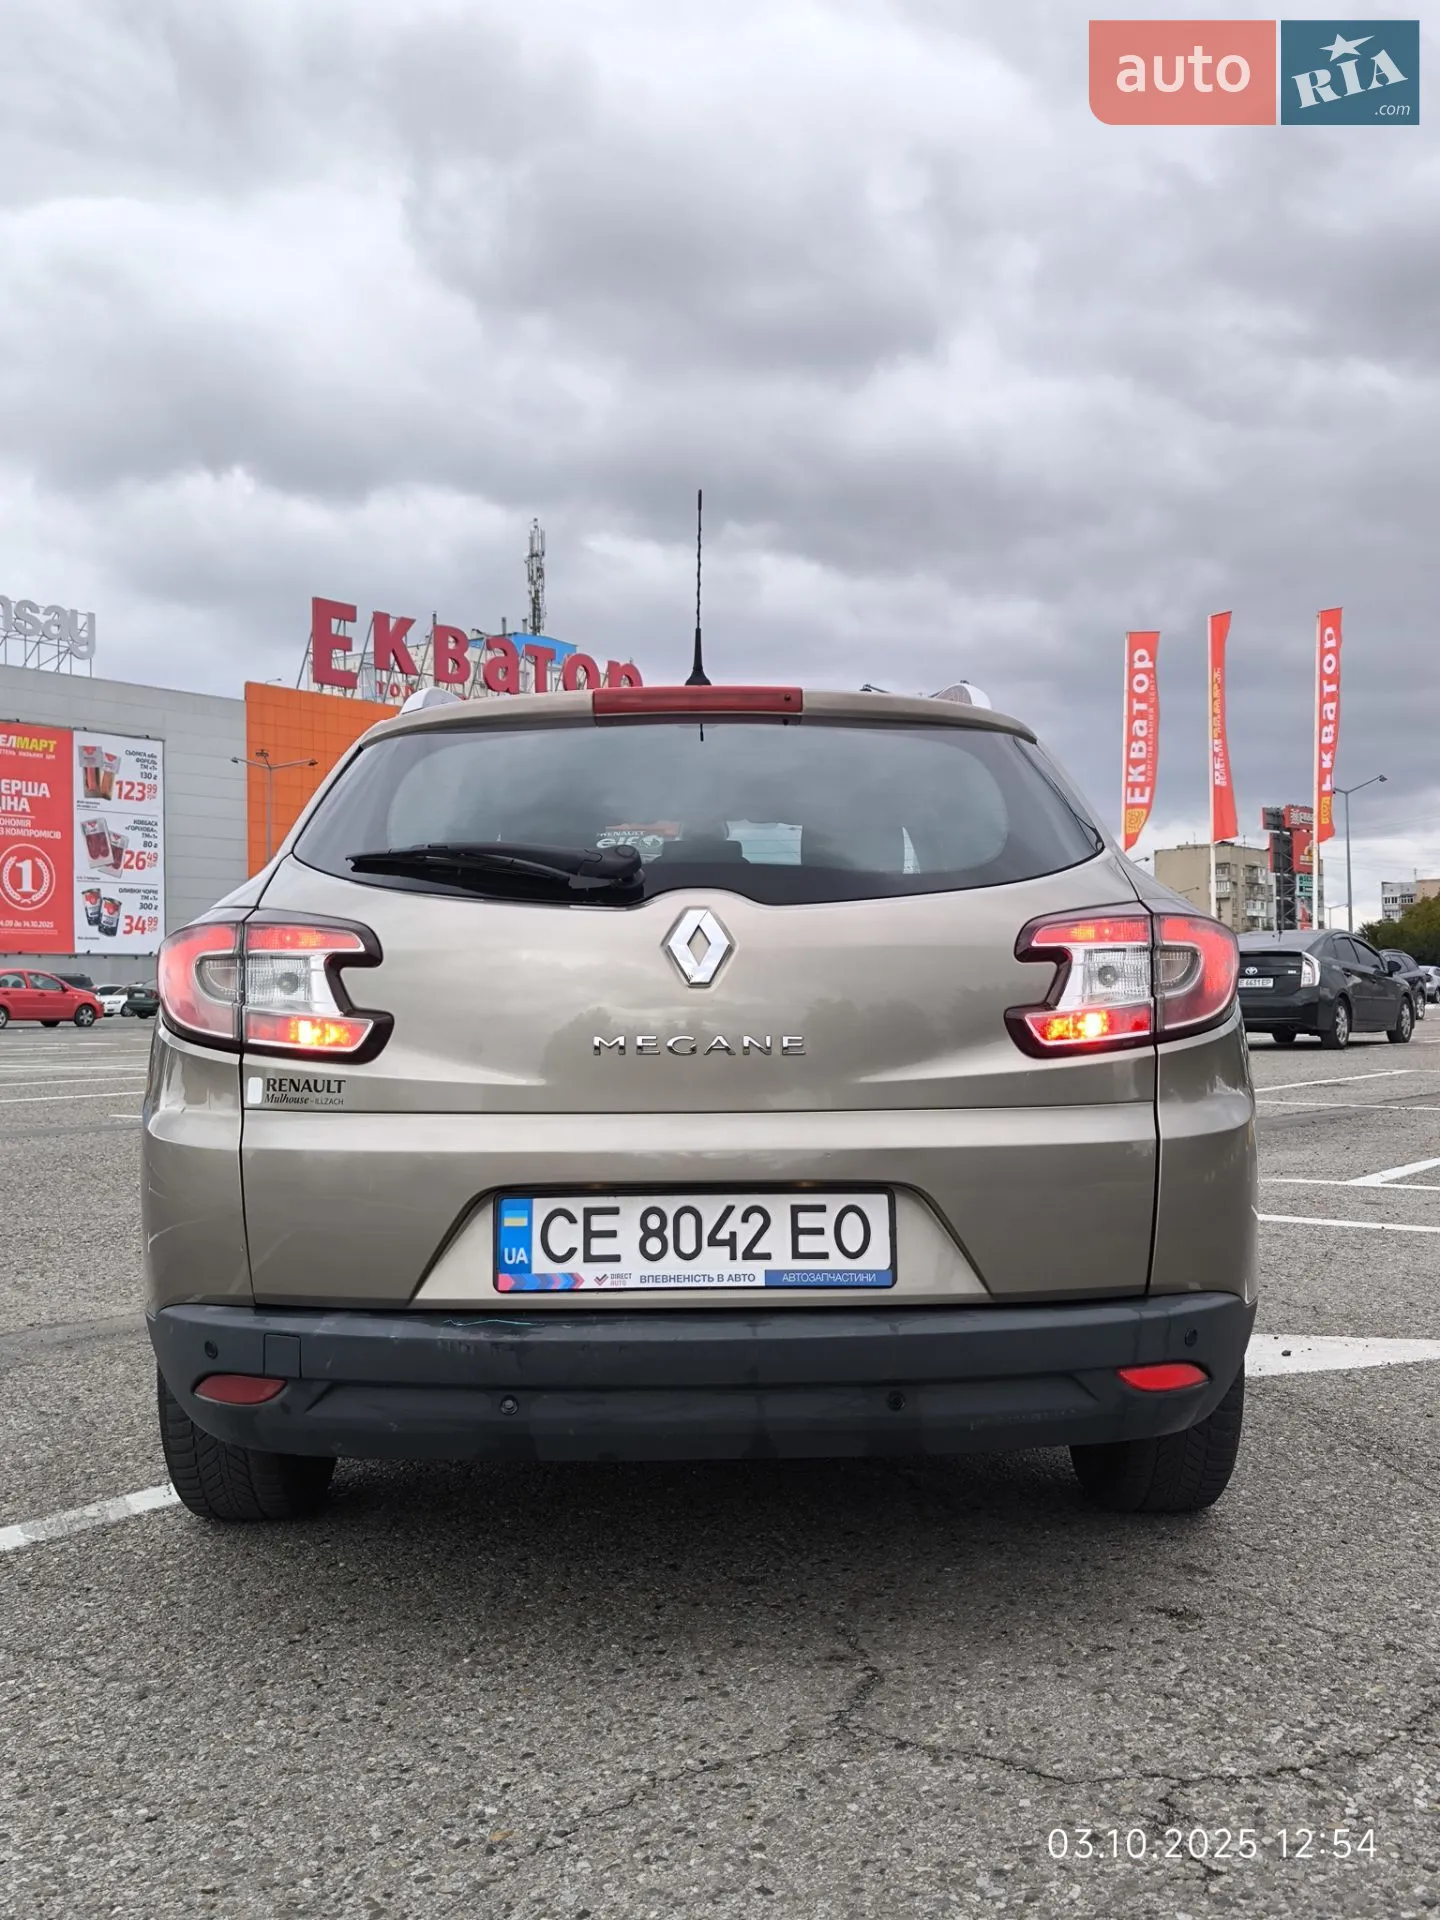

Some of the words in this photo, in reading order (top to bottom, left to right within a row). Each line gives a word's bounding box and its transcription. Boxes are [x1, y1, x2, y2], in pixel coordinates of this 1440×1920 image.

[116, 780, 146, 802] 123
[0, 795, 31, 813] ІНА
[123, 850, 146, 870] 26
[123, 915, 146, 934] 34
[593, 1035, 807, 1056] MEGANE
[266, 1078, 346, 1094] RENAULT
[540, 1207, 621, 1264] CE
[638, 1204, 772, 1262] 8042
[790, 1204, 871, 1260] EO
[504, 1248, 528, 1264] UA
[640, 1274, 714, 1284] ВПЕВНЕНІСТЬ
[717, 1274, 724, 1283] В
[727, 1273, 756, 1283] АВТО
[782, 1272, 877, 1283] АВТОЗАПЧАСТИНИ
